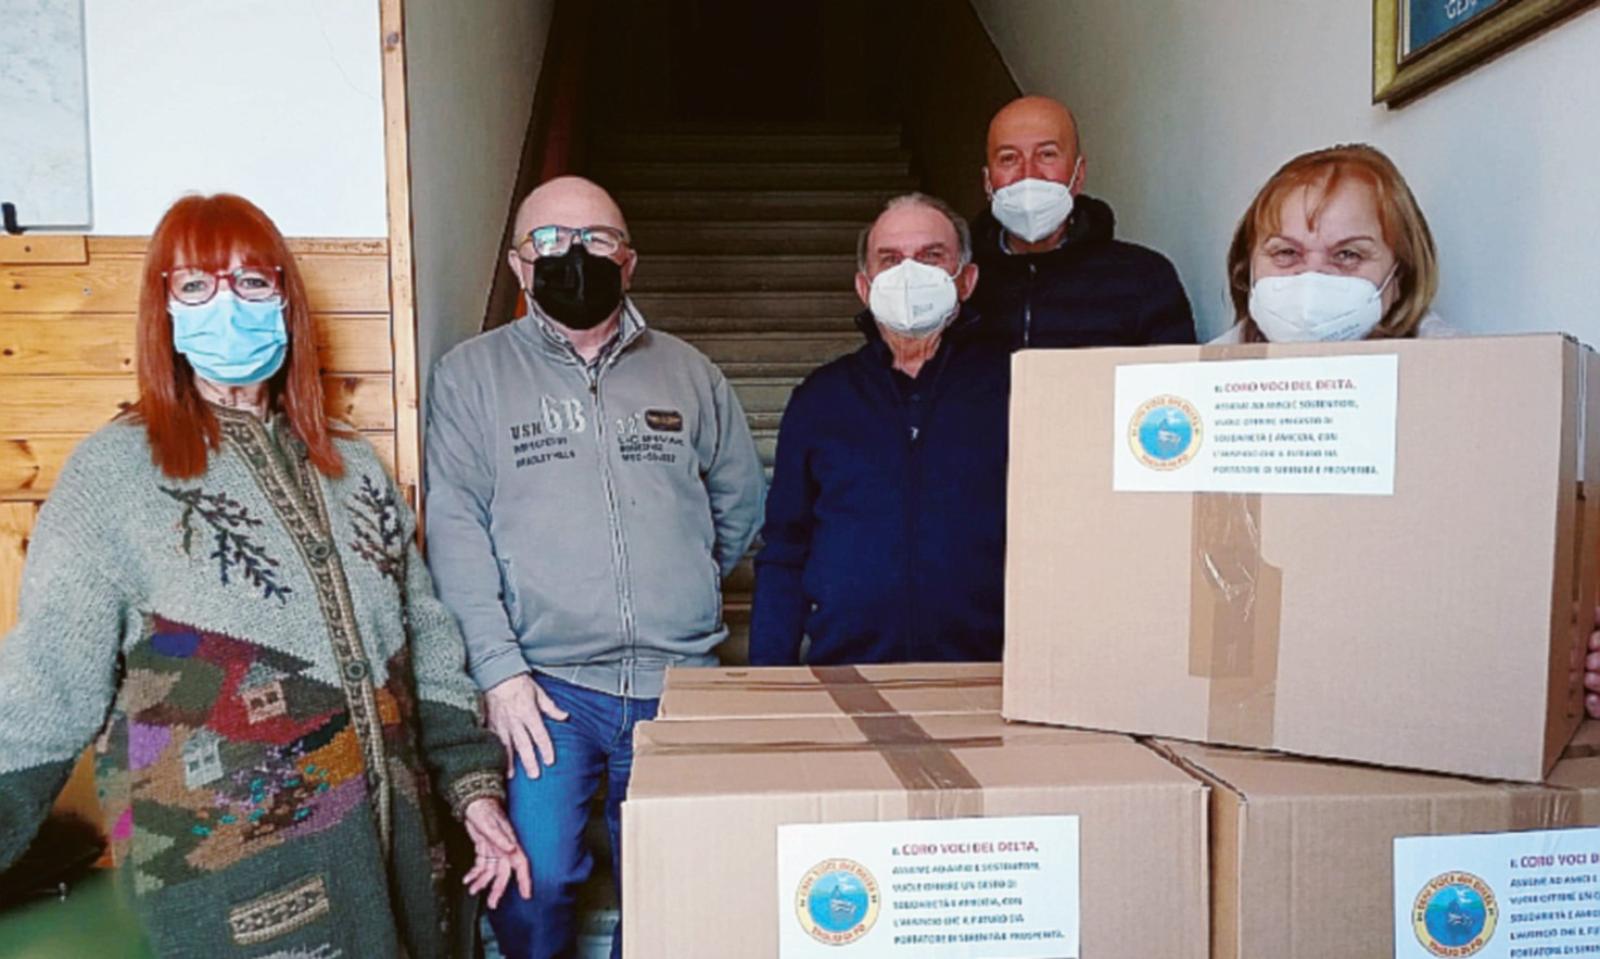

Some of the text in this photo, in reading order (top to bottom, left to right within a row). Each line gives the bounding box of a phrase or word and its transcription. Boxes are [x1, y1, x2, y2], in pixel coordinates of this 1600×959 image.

[1225, 382, 1258, 393] CORO
[1260, 381, 1289, 392] VOCI
[1291, 380, 1313, 391] DEL
[902, 844, 938, 856] CORO
[940, 843, 971, 854] VOCI
[972, 842, 995, 853] DEL
[1521, 856, 1554, 868] CORO
[1558, 854, 1587, 866] VOCI
